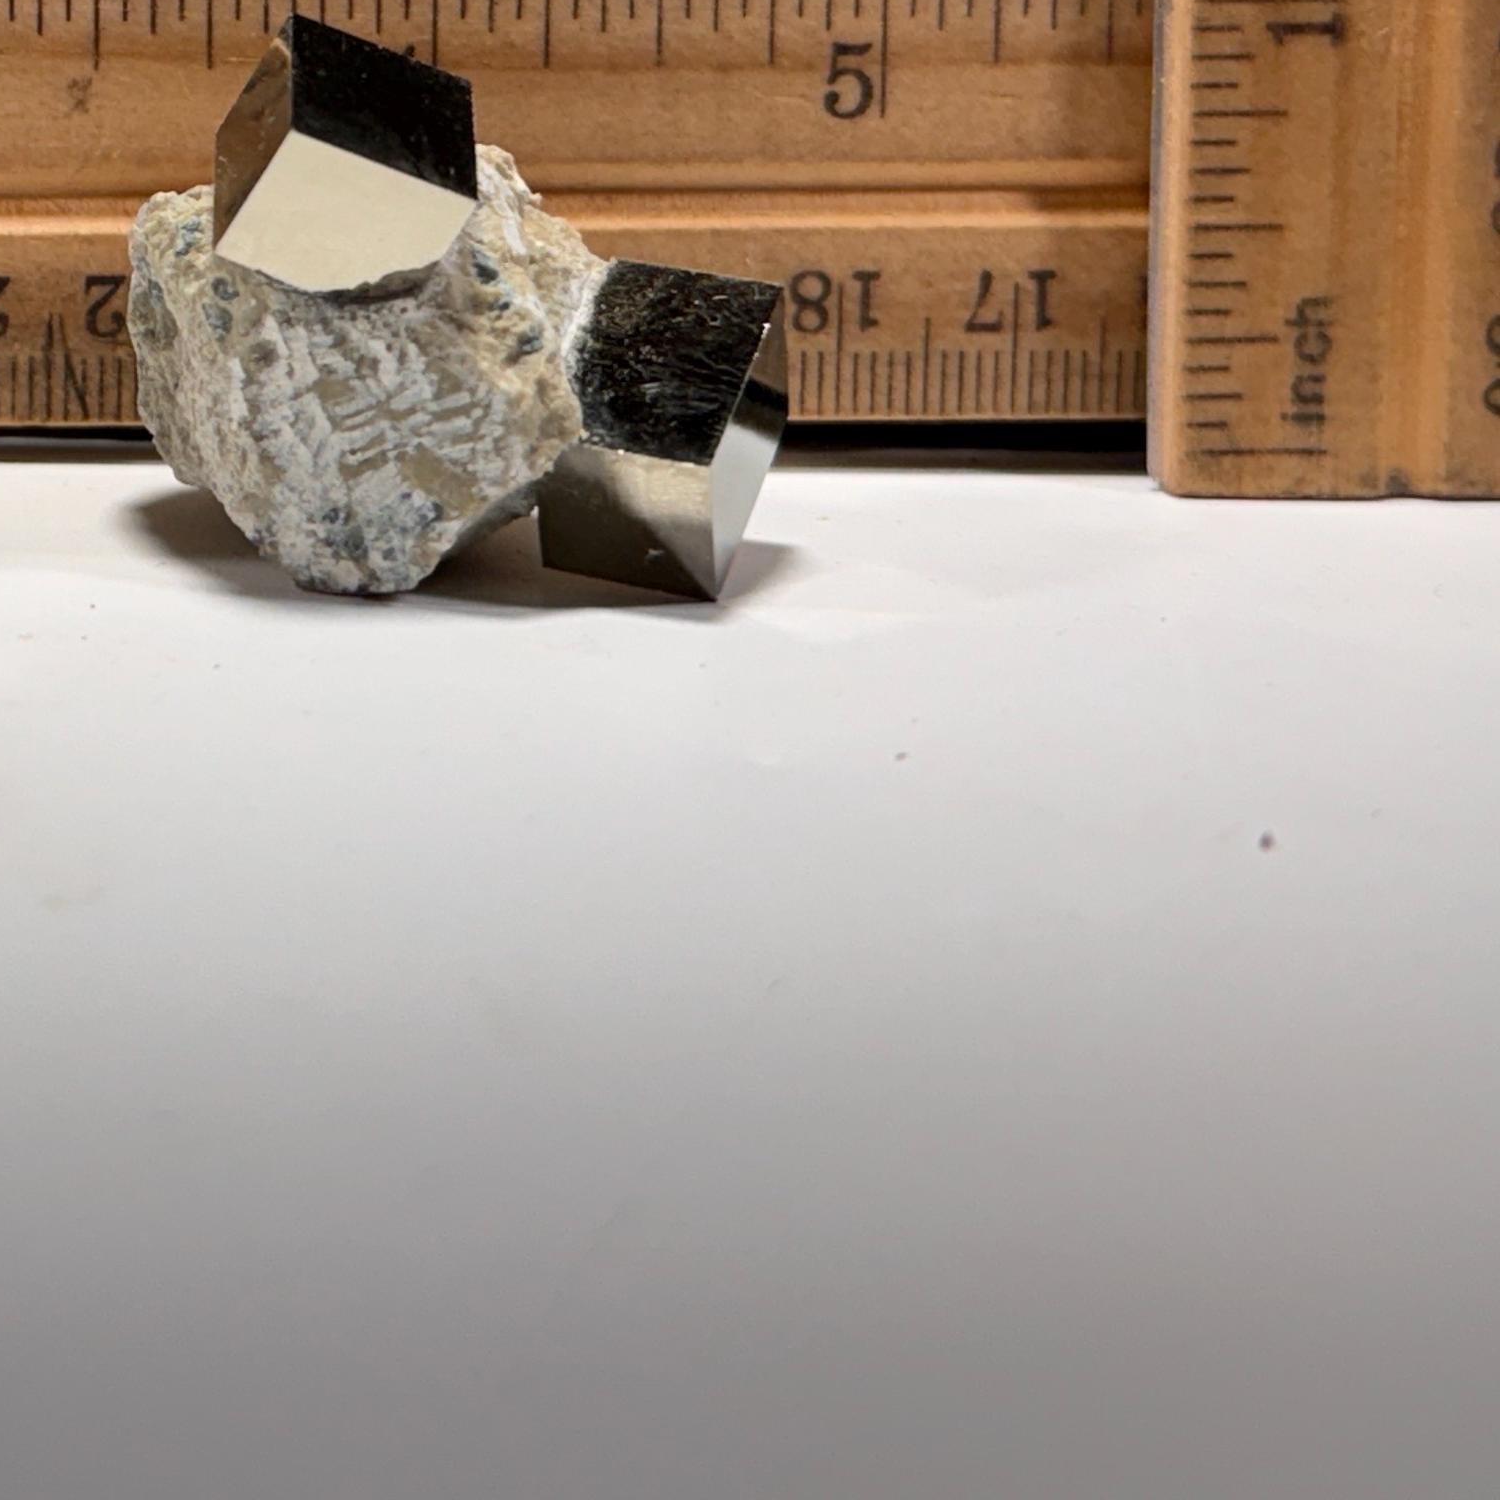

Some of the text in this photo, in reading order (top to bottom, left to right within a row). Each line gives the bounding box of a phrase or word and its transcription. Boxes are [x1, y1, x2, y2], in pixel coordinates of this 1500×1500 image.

[1266, 12, 1345, 46] 1
[823, 41, 874, 119] 5
[789, 270, 881, 333] 18
[964, 270, 1057, 332] 17
[1280, 295, 1334, 427] inch
